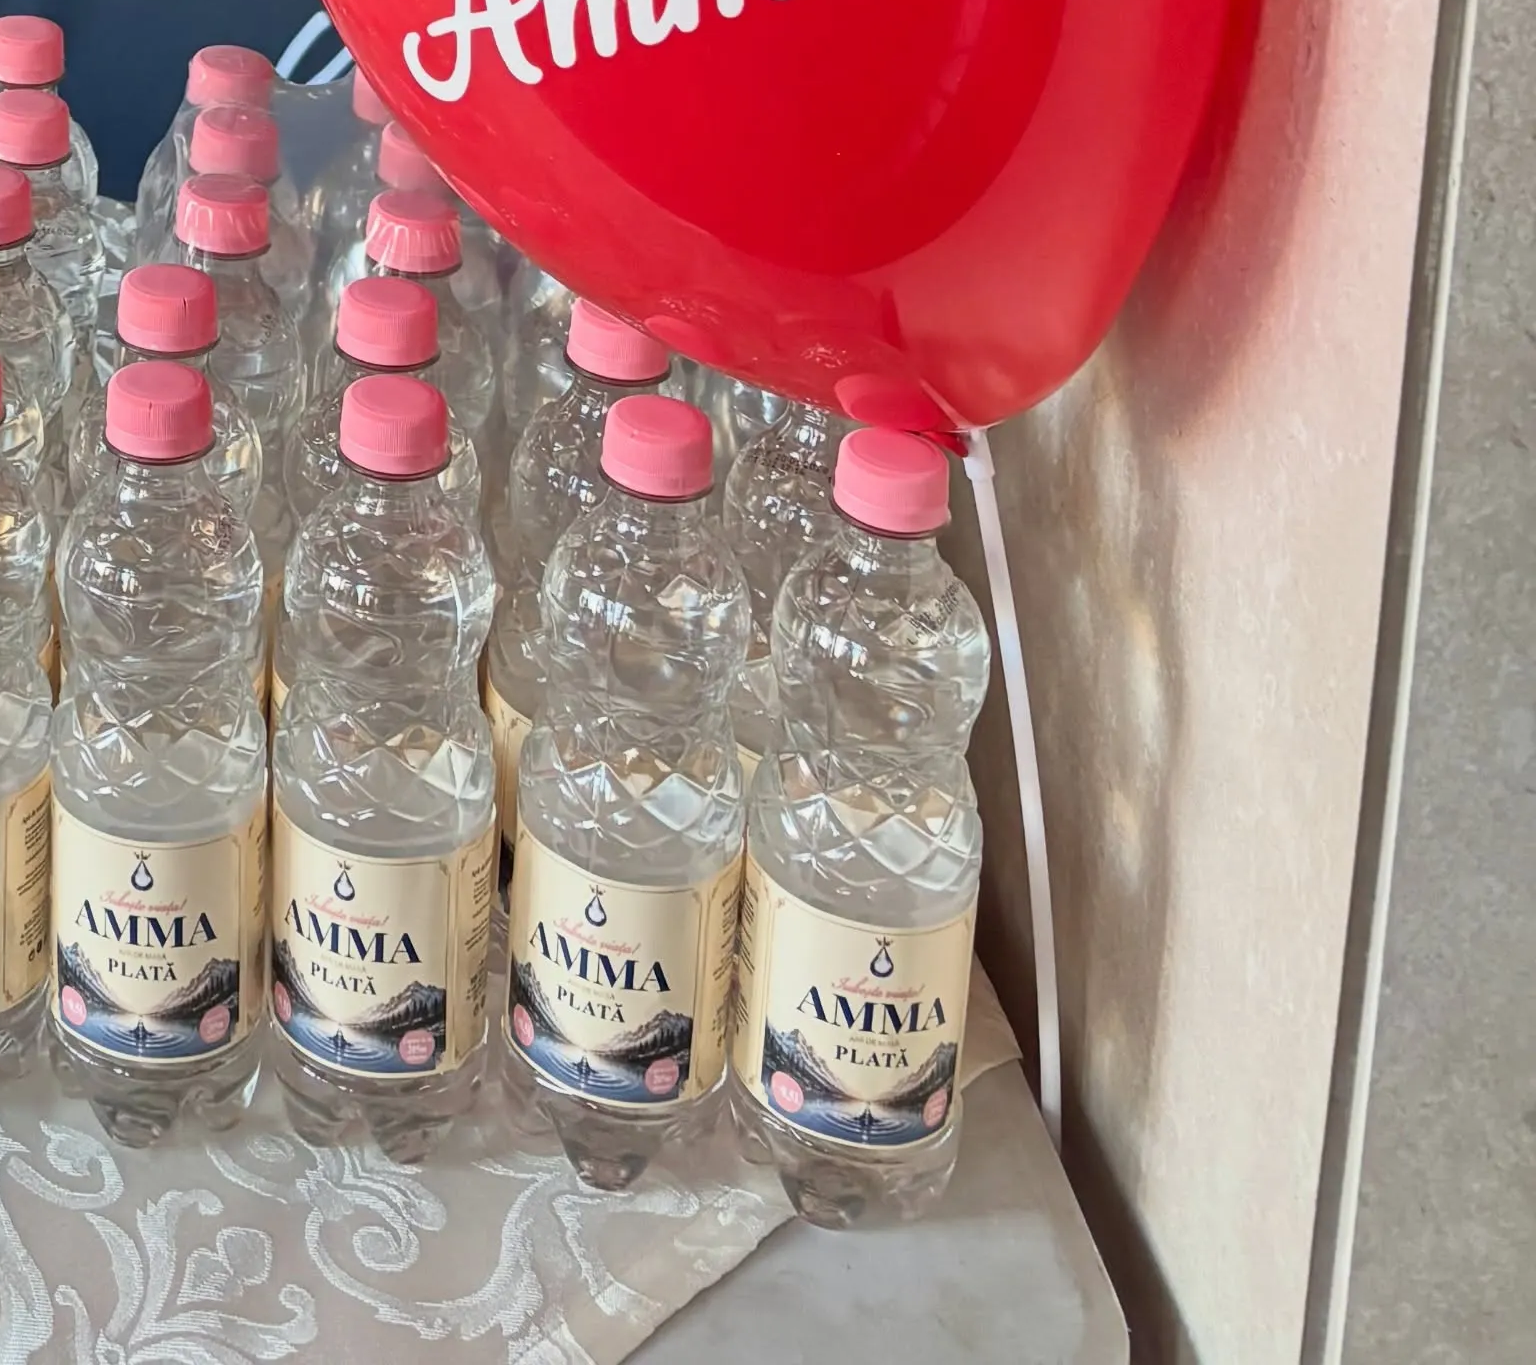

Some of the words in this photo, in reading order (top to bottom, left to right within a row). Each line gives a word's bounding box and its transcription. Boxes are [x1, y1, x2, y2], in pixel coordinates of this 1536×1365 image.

[75, 899, 218, 949] AMMA
[284, 898, 423, 964] AMMA
[108, 957, 178, 982] PLATĂ
[311, 961, 377, 995] PLATĂ
[529, 921, 672, 993] AMMA
[557, 984, 626, 1023] PLATĂ
[796, 985, 946, 1035] AMMA
[835, 1044, 909, 1069] PLATĂ
